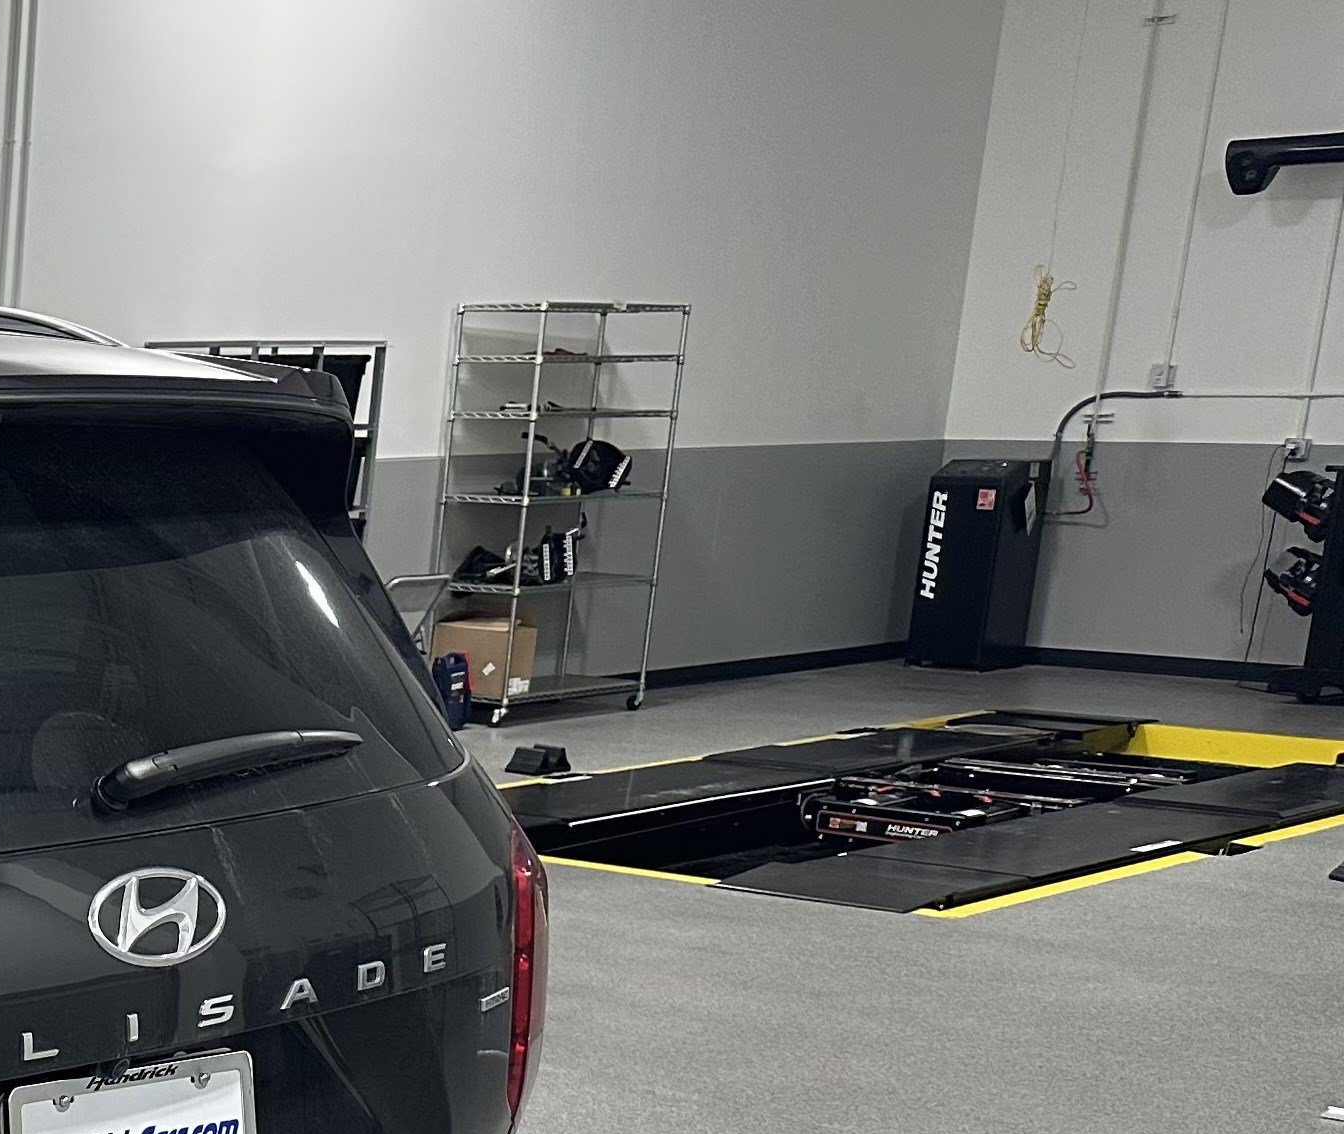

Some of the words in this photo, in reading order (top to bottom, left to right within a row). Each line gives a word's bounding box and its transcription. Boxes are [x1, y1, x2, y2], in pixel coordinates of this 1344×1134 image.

[919, 490, 949, 600] HUNTER
[886, 823, 940, 838] HUNTER
[86, 1064, 178, 1091] Hendrick
